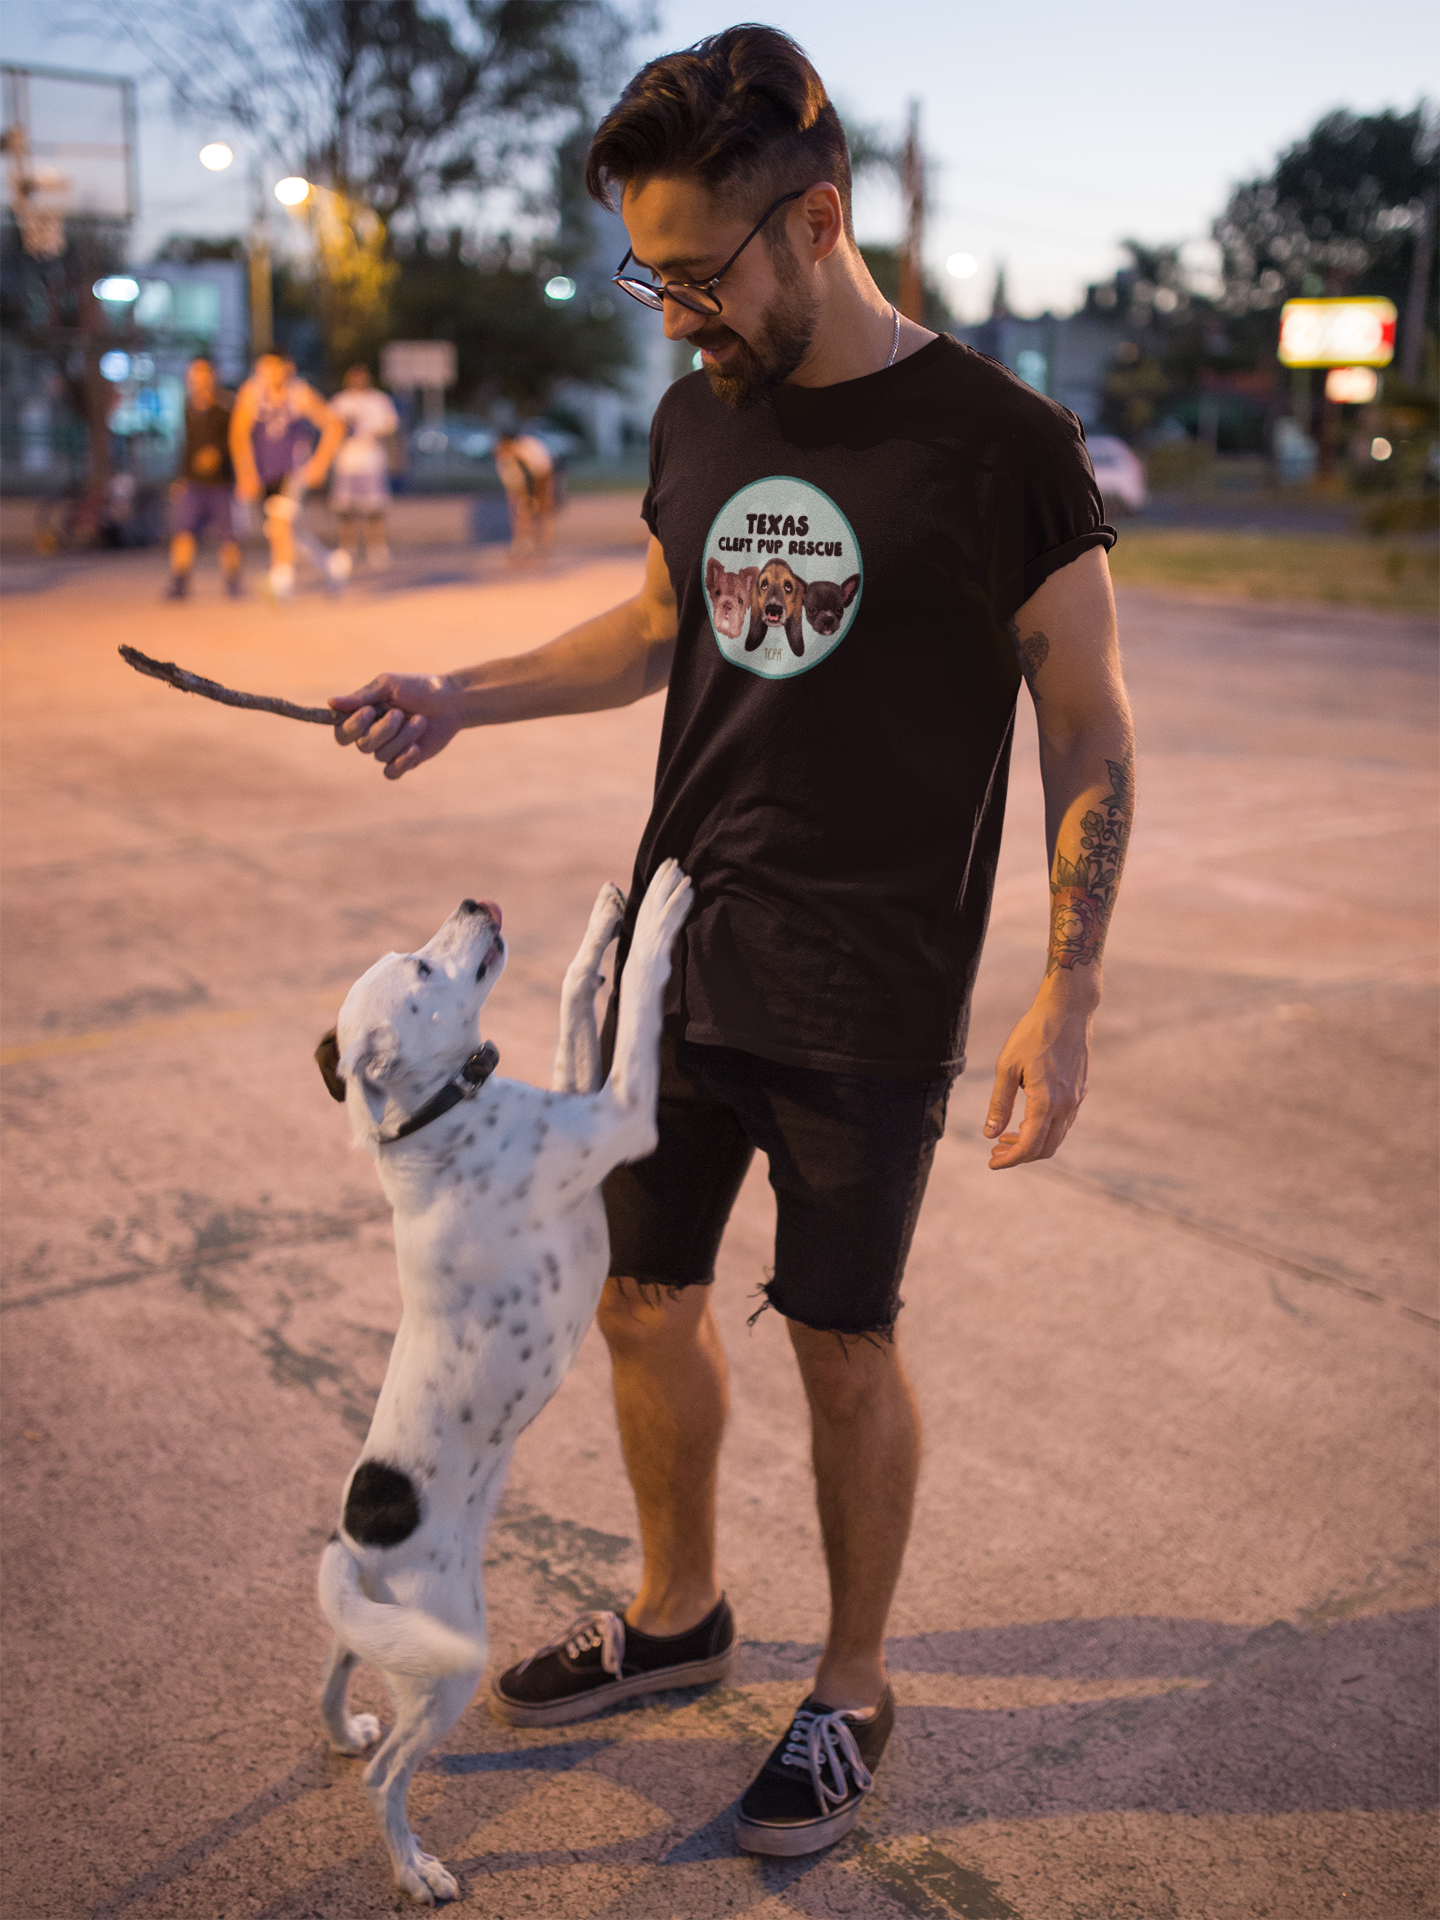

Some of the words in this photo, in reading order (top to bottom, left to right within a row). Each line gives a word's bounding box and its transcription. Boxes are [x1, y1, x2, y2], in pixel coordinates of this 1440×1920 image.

[746, 513, 809, 536] TEXAS
[718, 537, 753, 552] CLEFT
[757, 540, 783, 554] PUP
[788, 541, 842, 557] RESCUE
